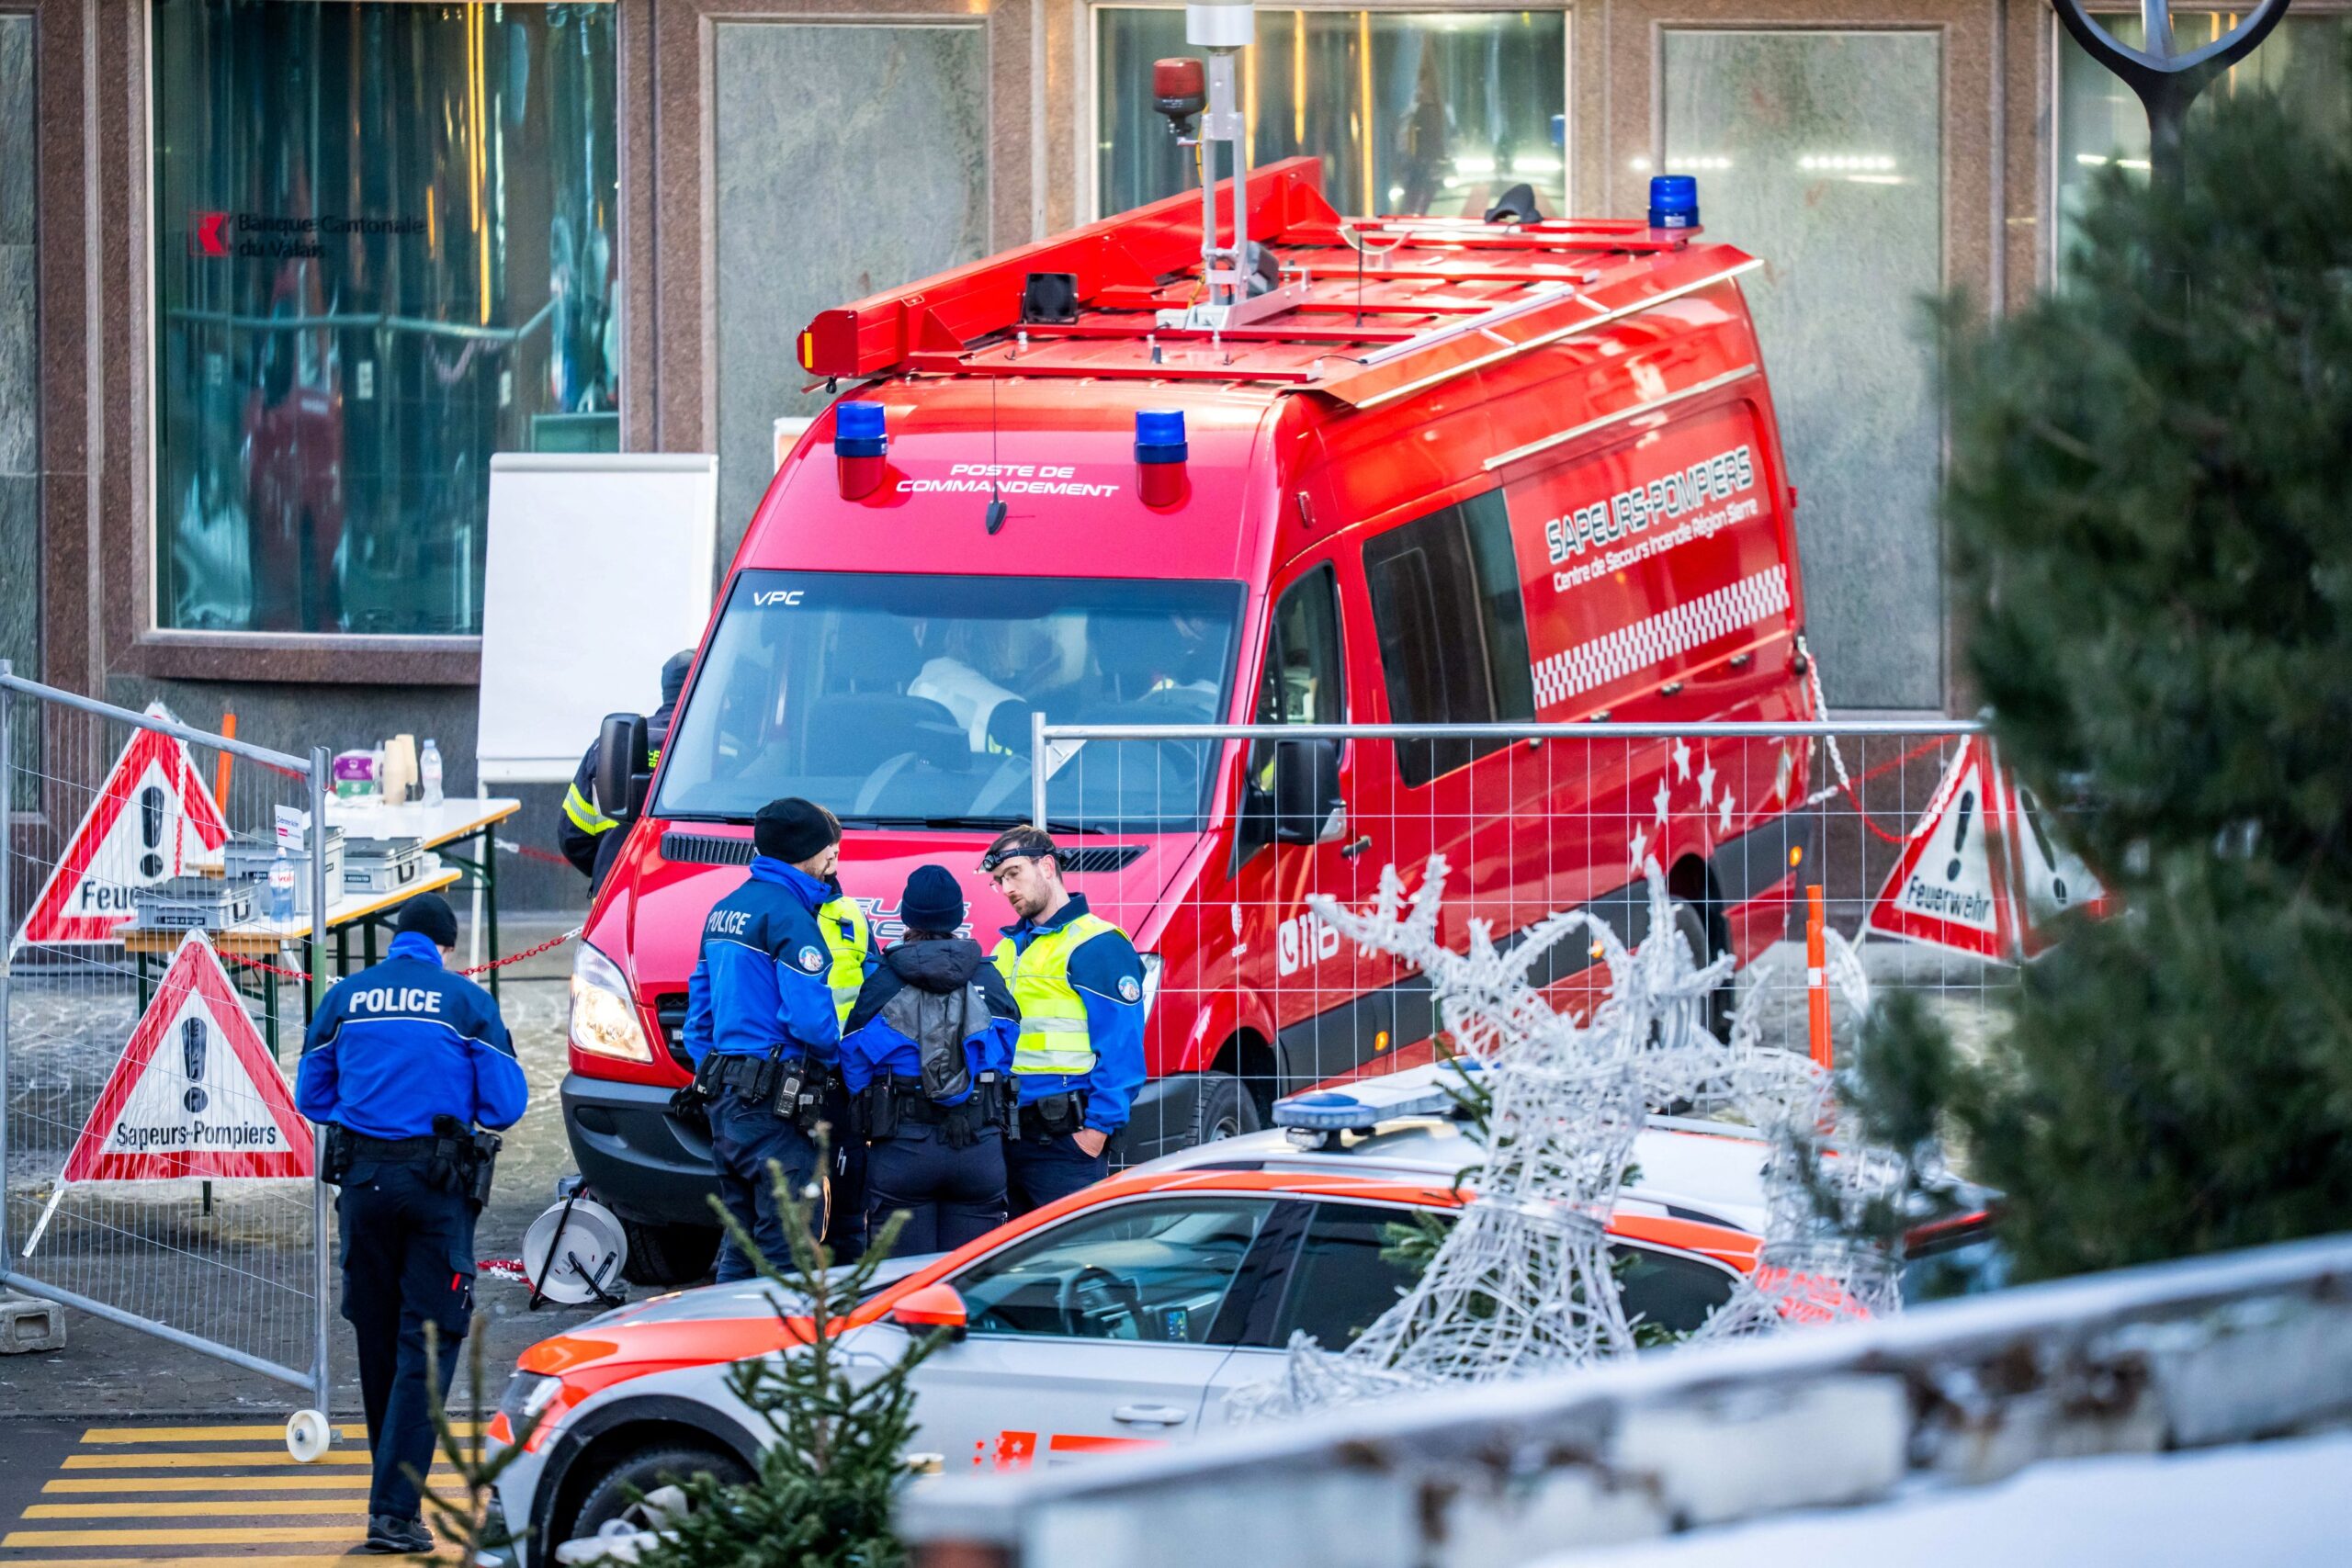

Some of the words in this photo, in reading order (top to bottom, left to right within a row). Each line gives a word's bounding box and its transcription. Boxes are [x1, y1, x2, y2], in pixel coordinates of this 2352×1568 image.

[239, 213, 313, 237] Banque
[322, 215, 426, 236] Cantonale
[239, 240, 264, 257] du
[268, 240, 325, 259] Valais
[950, 464, 1034, 478] POSTE
[1038, 466, 1075, 479] DE
[896, 479, 1120, 498] COMMANDEMENT
[1545, 445, 1754, 565] SAPEURS-POMPIERS
[1554, 564, 1591, 592] Centre
[1590, 556, 1607, 579] de
[1605, 541, 1650, 572] Secours
[1648, 521, 1693, 554] Incendie
[1691, 510, 1728, 539] Région
[1725, 498, 1758, 524] Sierre
[753, 591, 805, 606] VPC
[1906, 875, 1990, 922] Feuerwehr
[706, 910, 752, 935] POLICE
[349, 987, 443, 1013] POLICE
[117, 1120, 277, 1150] Sapeurs-Pompiers
